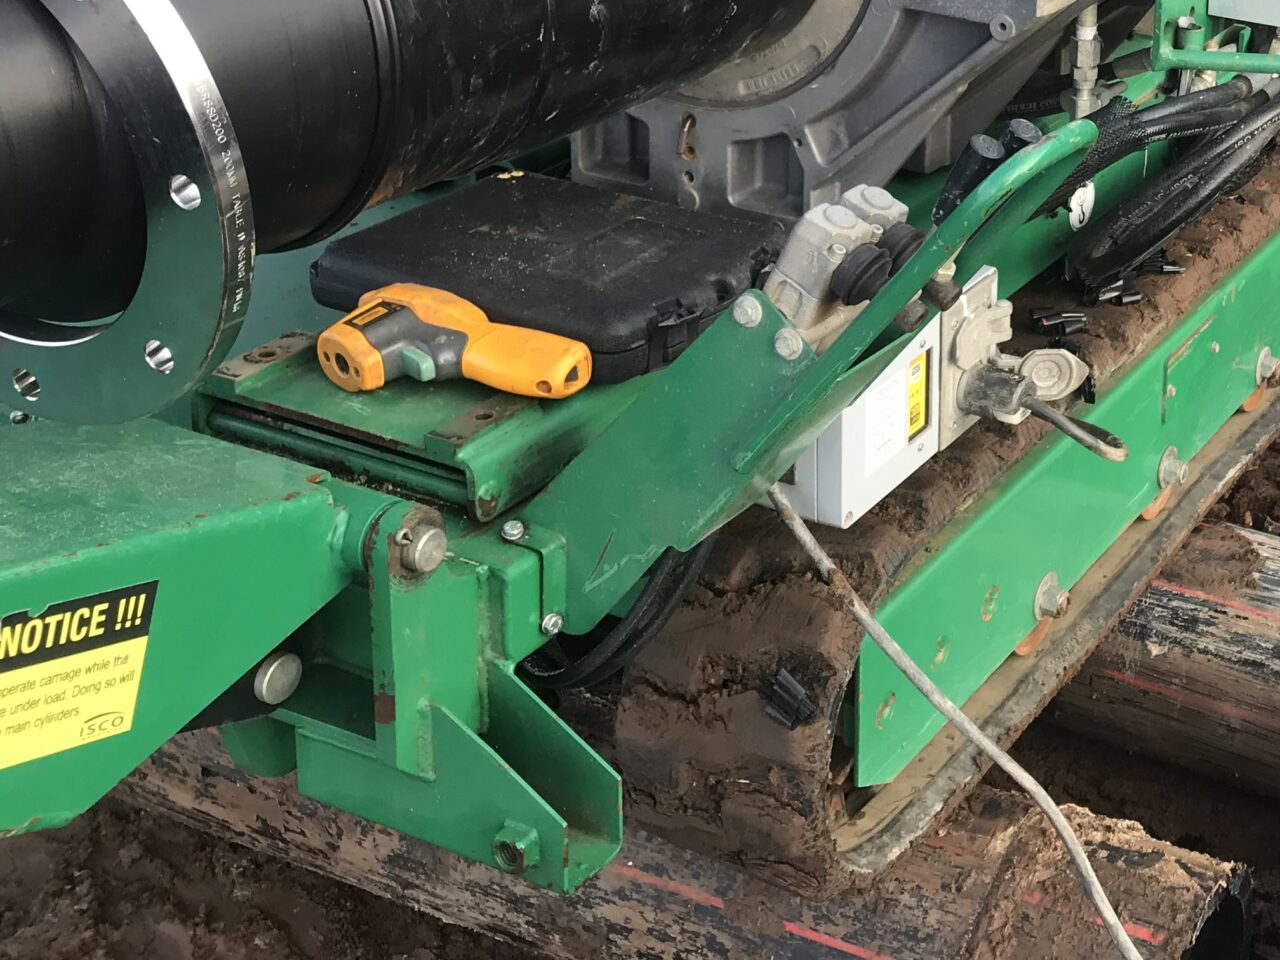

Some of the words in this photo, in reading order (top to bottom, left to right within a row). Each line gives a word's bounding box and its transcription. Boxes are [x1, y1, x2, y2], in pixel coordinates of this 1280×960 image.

[0, 602, 109, 660] NOTICE
[85, 658, 111, 675] while
[10, 698, 41, 715] under
[71, 681, 102, 698] Doing
[104, 677, 117, 689] so
[120, 669, 135, 685] will
[4, 720, 31, 736] main
[80, 715, 124, 737] ISCO
